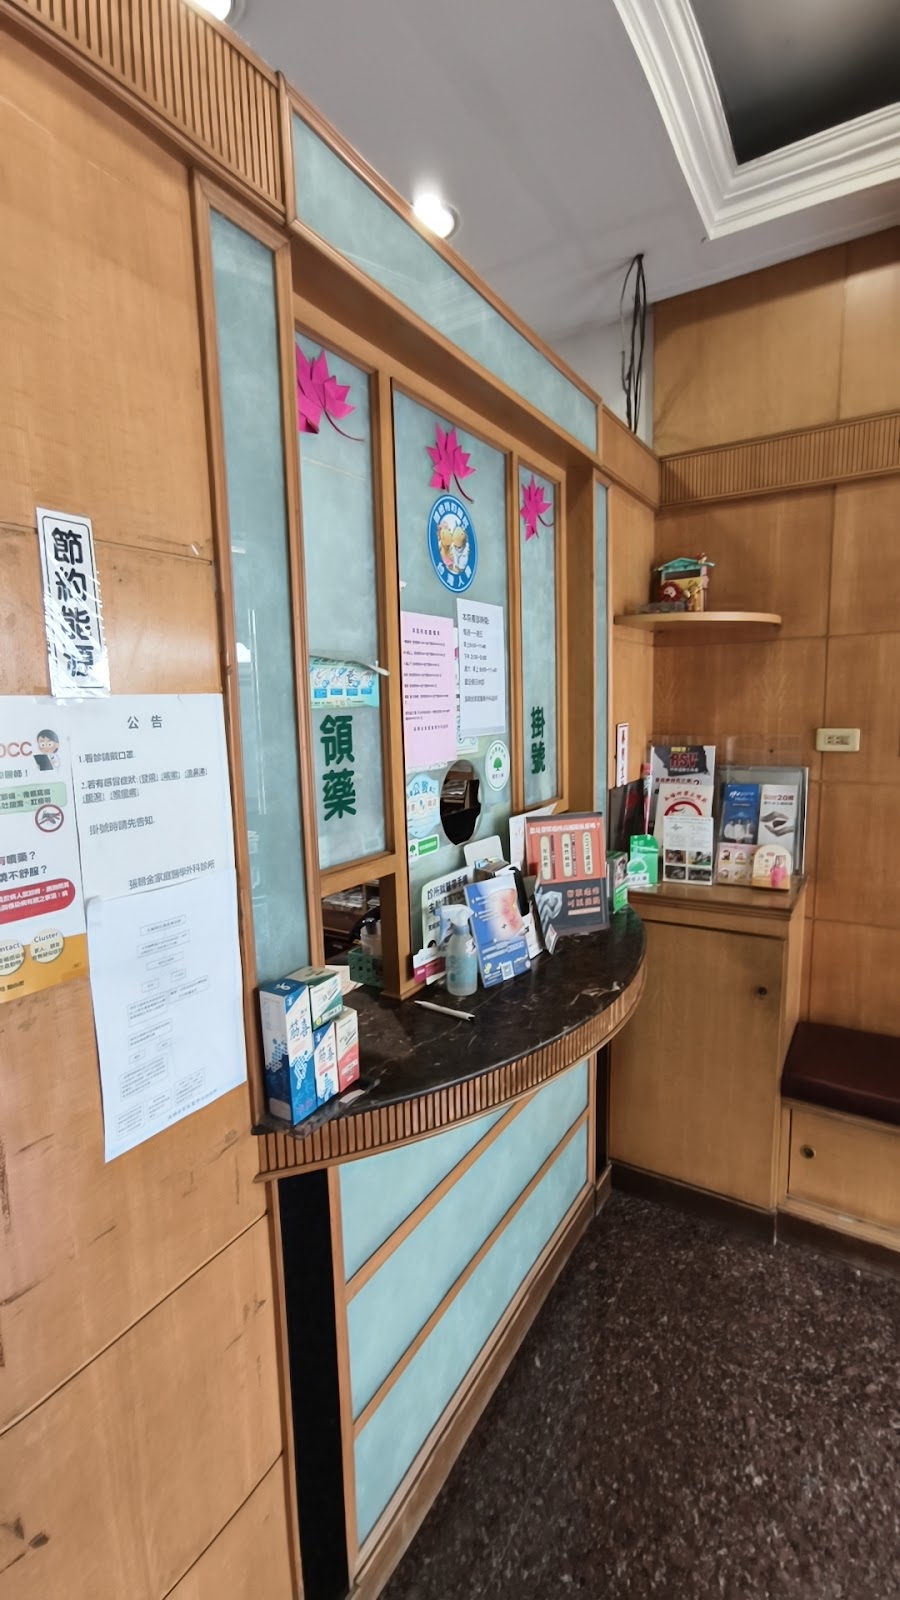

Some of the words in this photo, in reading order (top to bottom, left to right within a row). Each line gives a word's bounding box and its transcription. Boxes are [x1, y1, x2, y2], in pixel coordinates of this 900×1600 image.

[51, 526, 95, 678] 節約能源
[319, 714, 357, 821] 領藥
[531, 705, 546, 775] 掛號
[670, 752, 698, 768] RSV
[34, 931, 59, 943] Cluster
